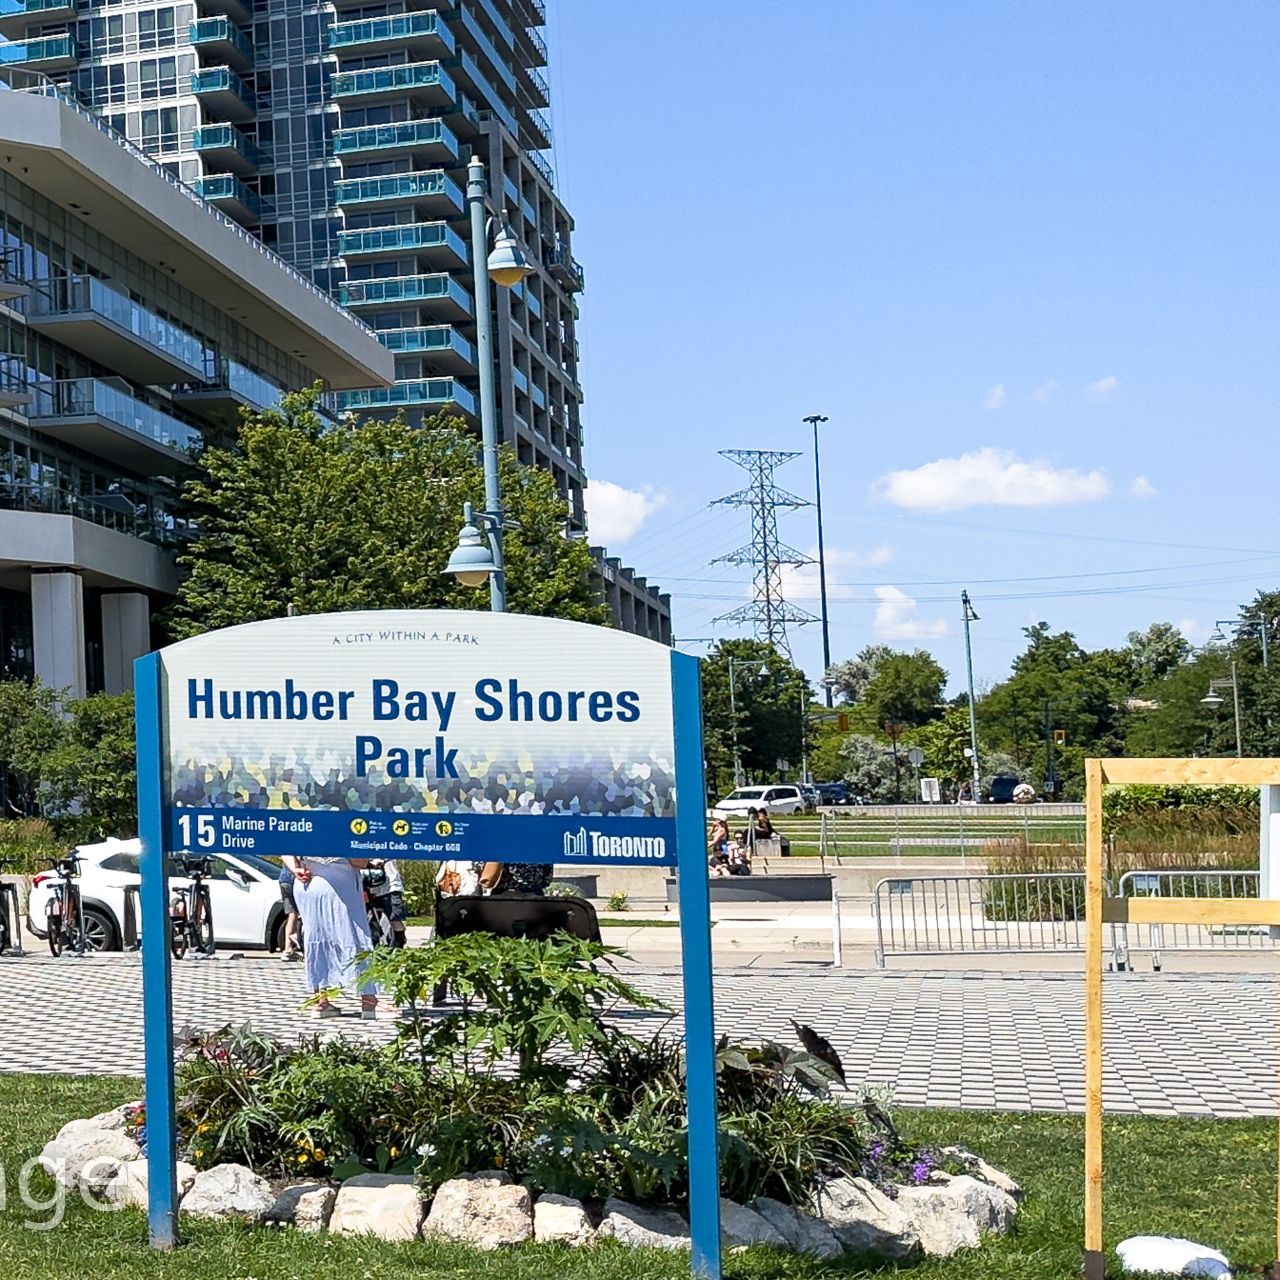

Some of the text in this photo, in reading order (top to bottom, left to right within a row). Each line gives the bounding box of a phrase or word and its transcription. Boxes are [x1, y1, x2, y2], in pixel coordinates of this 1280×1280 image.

[333, 631, 479, 645] A CITY WITHIN A PARK
[188, 678, 640, 732] Humber Bay Shores
[356, 735, 459, 779] Park
[178, 814, 215, 847] 15
[222, 816, 313, 832] Marine Parade
[222, 833, 255, 849] Drive
[589, 831, 665, 858] TORONTO
